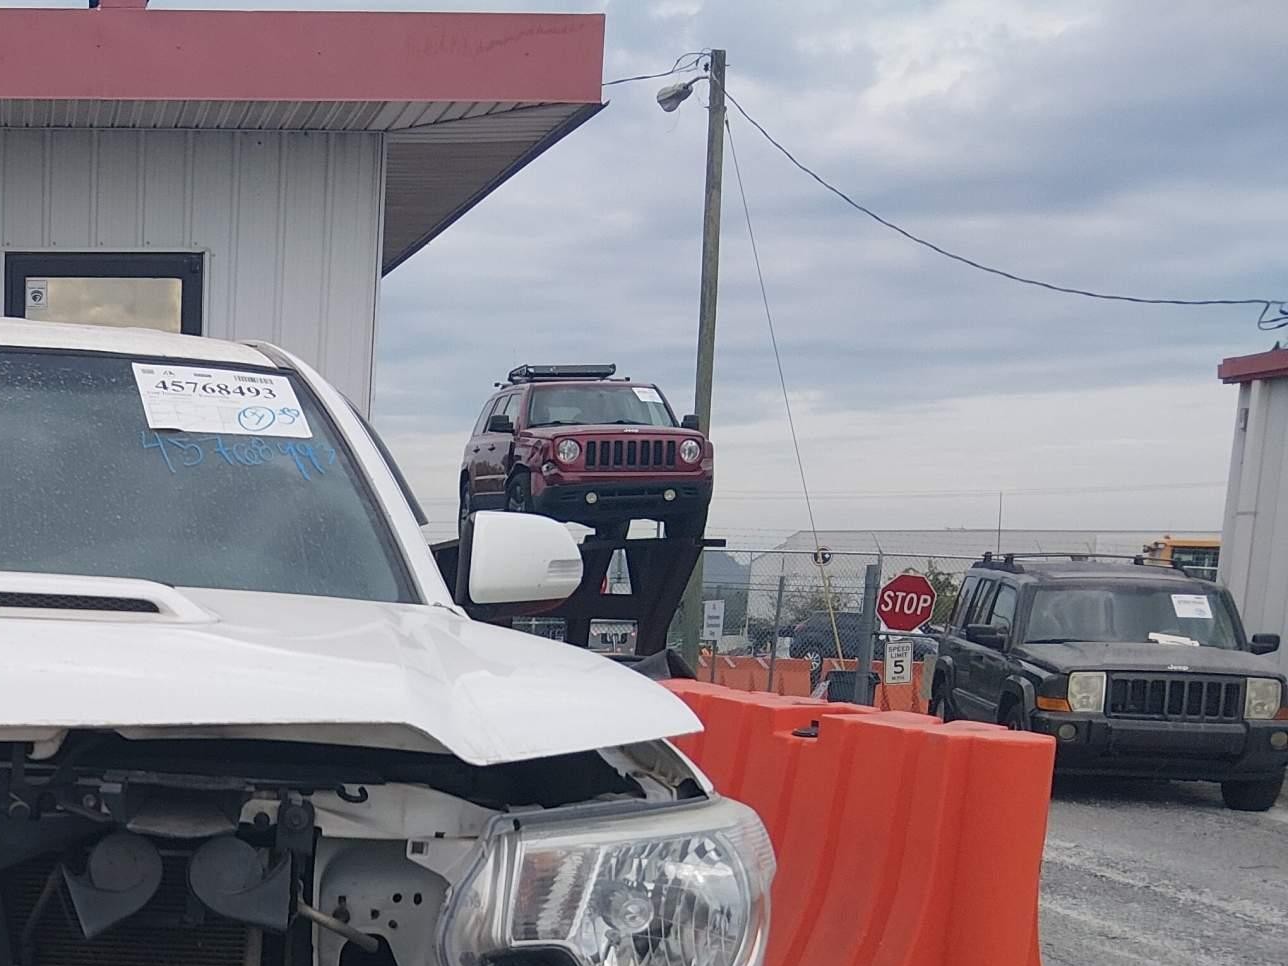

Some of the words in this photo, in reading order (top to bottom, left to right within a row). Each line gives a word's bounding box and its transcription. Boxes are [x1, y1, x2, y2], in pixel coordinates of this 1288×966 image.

[155, 380, 276, 399] 45768493
[881, 590, 932, 615] STOP
[893, 660, 904, 674] 5
